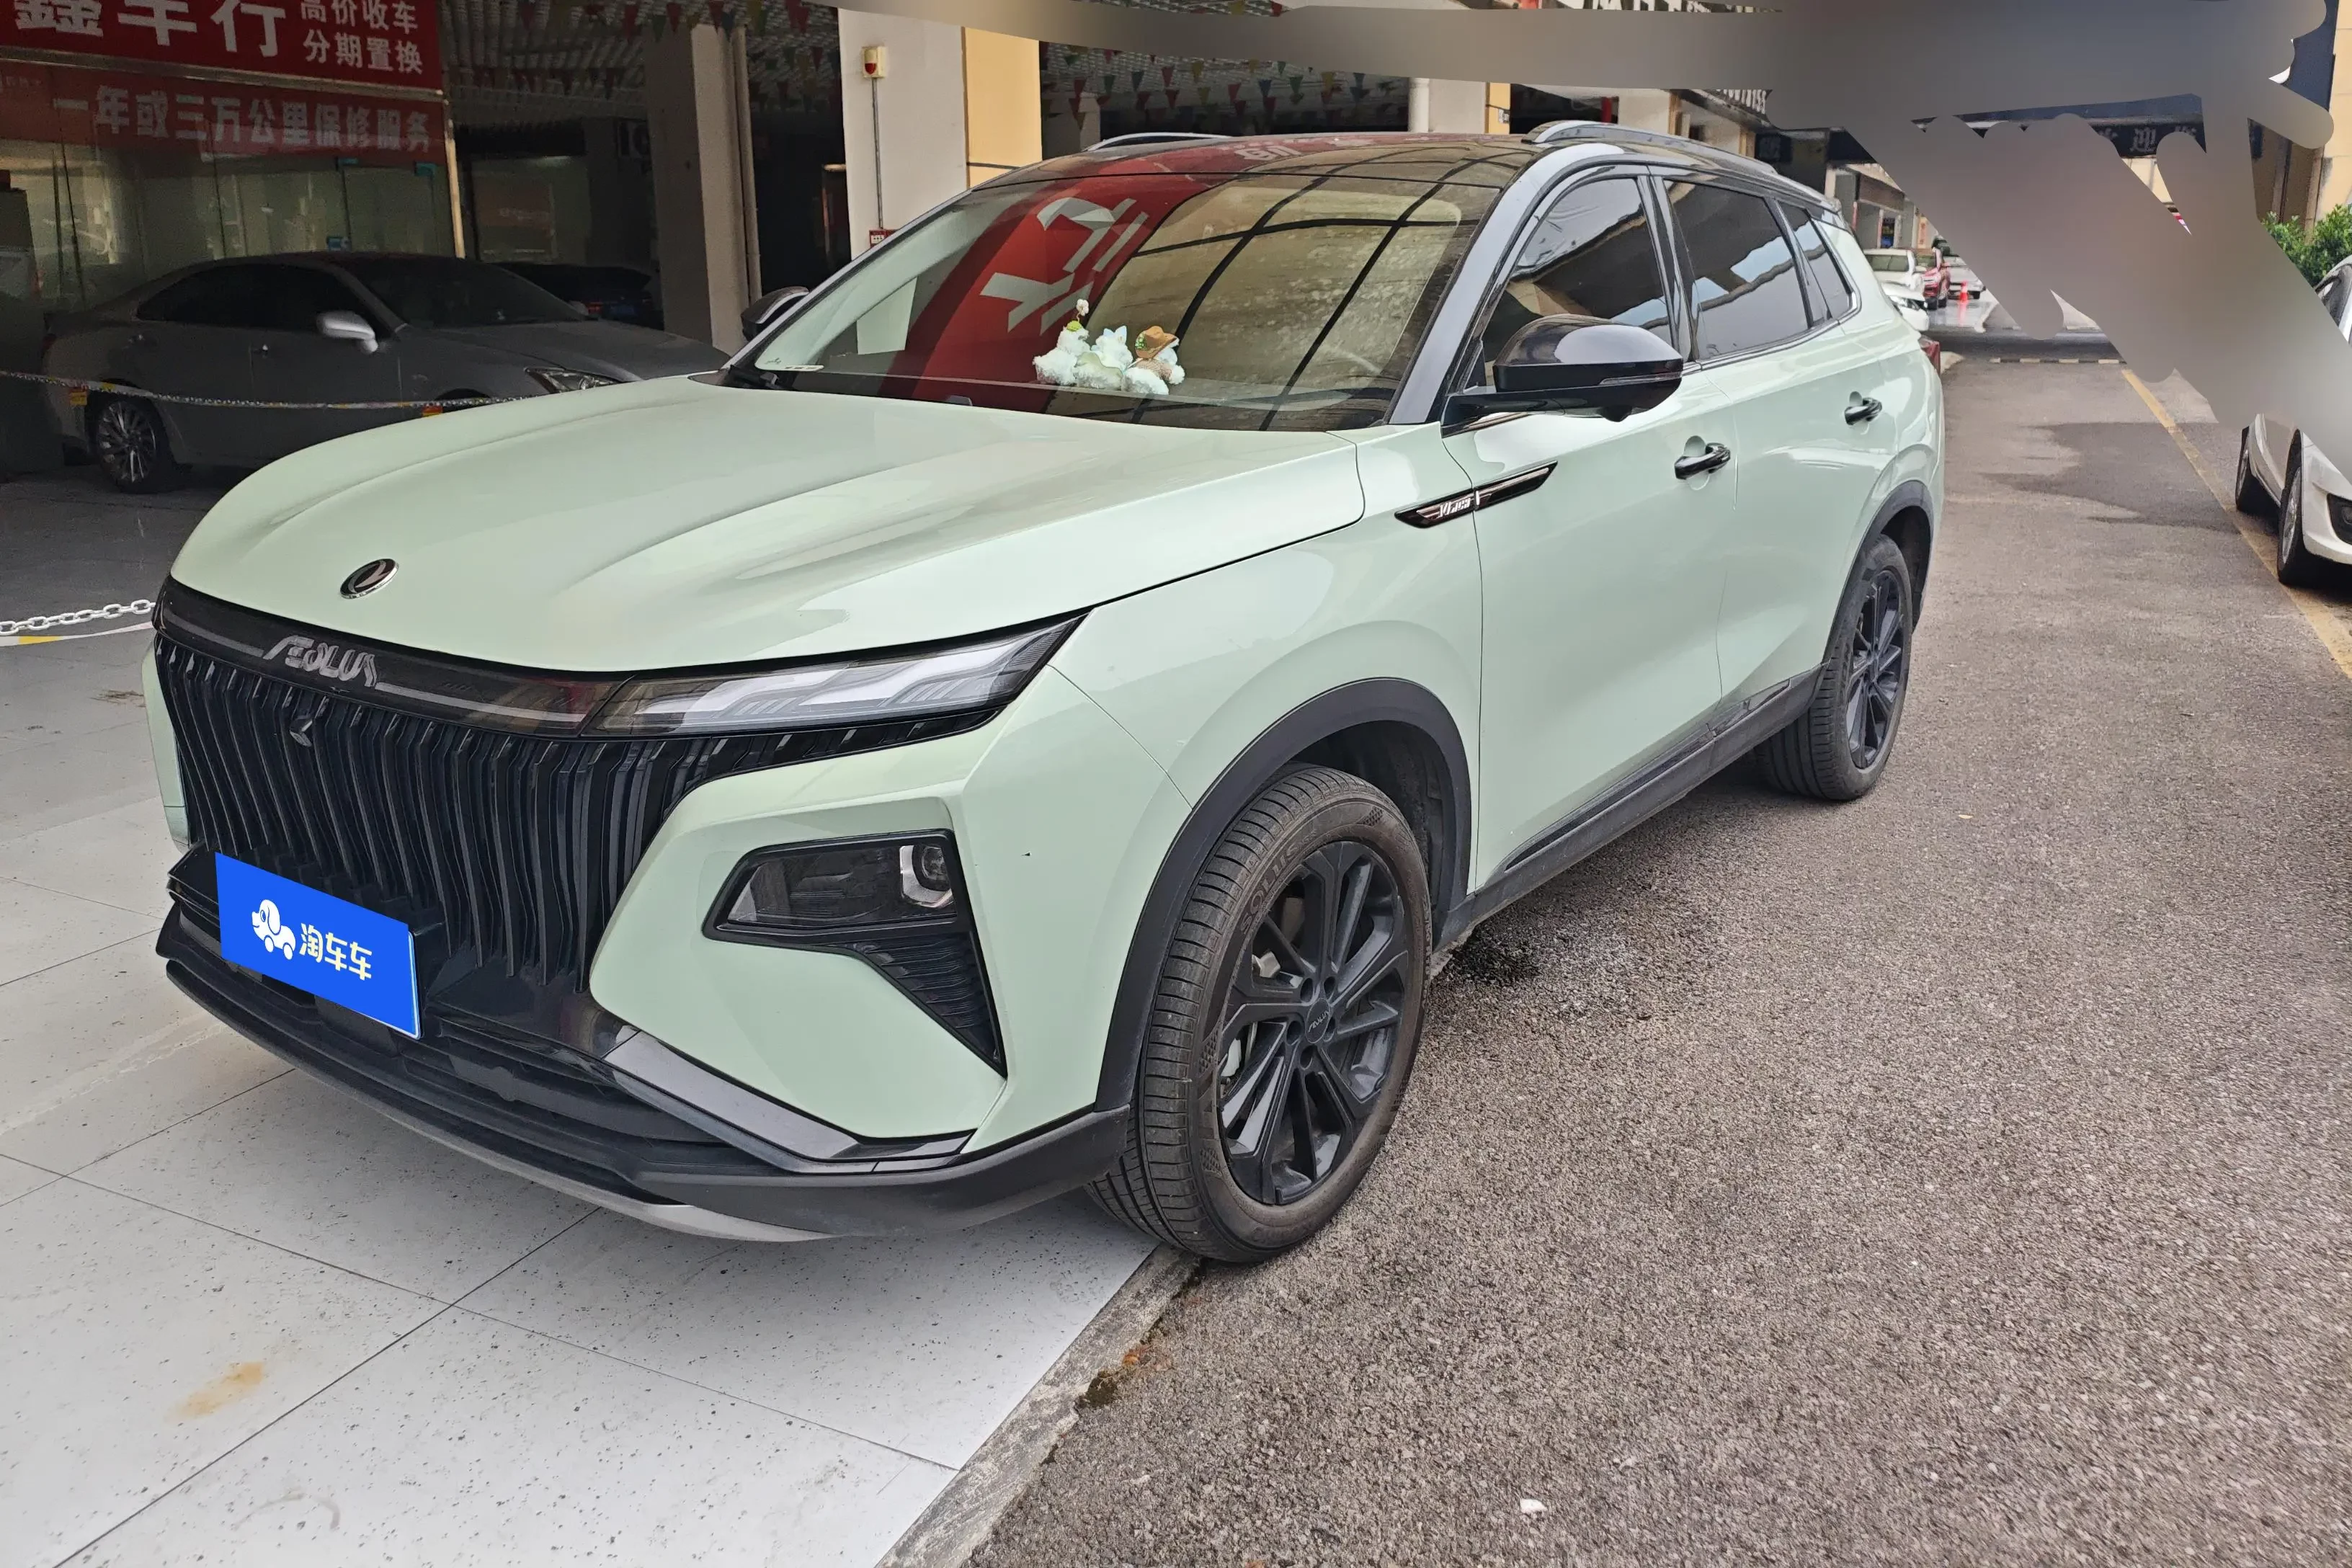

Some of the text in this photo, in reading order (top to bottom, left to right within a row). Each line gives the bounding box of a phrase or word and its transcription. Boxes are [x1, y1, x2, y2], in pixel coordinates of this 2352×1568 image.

[300, 0, 419, 35] 高价收车
[303, 28, 424, 75] 分期置换
[53, 84, 430, 153] 一年或三万公里保修服务
